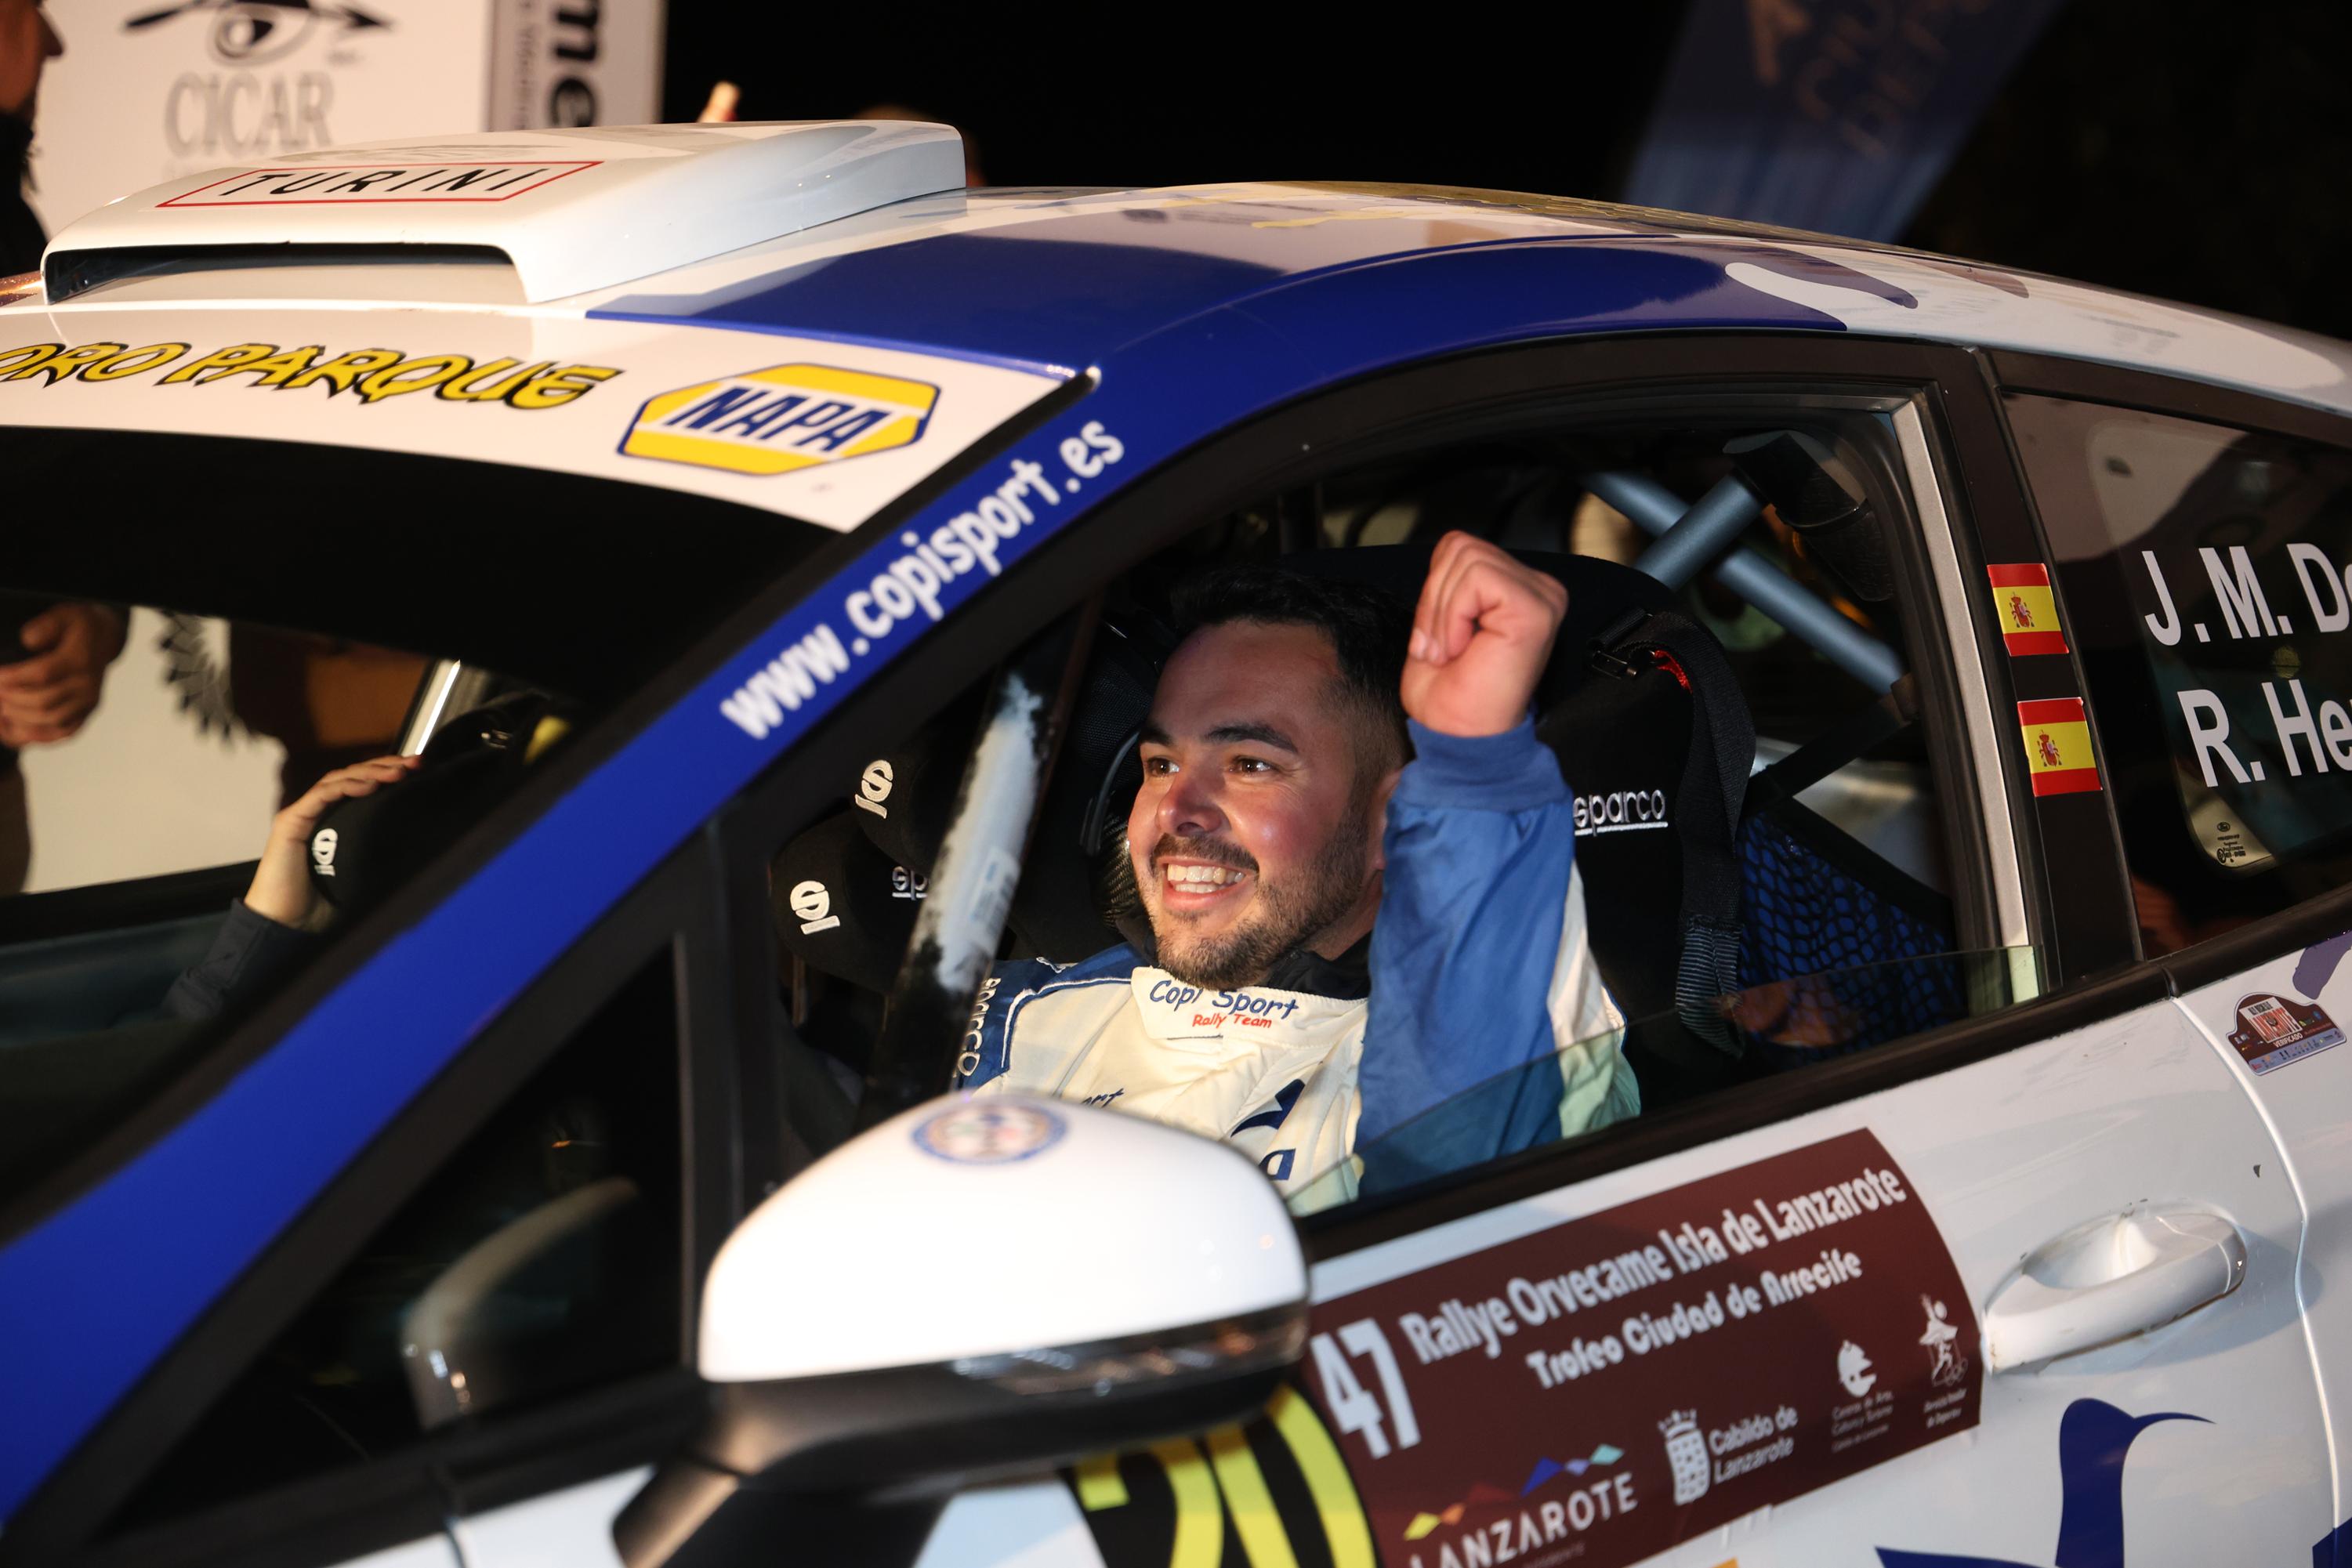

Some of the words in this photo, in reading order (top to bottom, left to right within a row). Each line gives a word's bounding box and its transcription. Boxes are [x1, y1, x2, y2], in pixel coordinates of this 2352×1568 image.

[163, 71, 335, 157] CICAR
[219, 167, 550, 197] TURINI
[153, 342, 626, 410] PARQUE
[663, 386, 892, 453] NAPA
[720, 421, 1124, 740] www.copisport.es
[2286, 542, 2352, 633] D
[2177, 689, 2266, 788] R.
[2261, 679, 2352, 777] He
[1572, 789, 1668, 837] sparco
[1192, 1013, 1227, 1029] Rally
[1233, 1013, 1272, 1029] Team
[1212, 990, 1299, 1020] Sport
[1310, 1317, 1421, 1459] 47
[1398, 1297, 1519, 1365] Rallye
[1506, 1276, 1674, 1326] Orvecame
[1658, 1221, 1729, 1274] Isla
[1722, 1208, 1769, 1255] de
[1753, 1167, 1908, 1242] Lanzarote
[1525, 1336, 1625, 1389] Trofeo
[1622, 1290, 1725, 1355] Ciudad
[1726, 1282, 1763, 1319] de
[1759, 1248, 1863, 1308] Arrecife
[1709, 1414, 1774, 1456] Cabildo
[1775, 1404, 1799, 1431] de
[1713, 1436, 1796, 1485] Lanzarote
